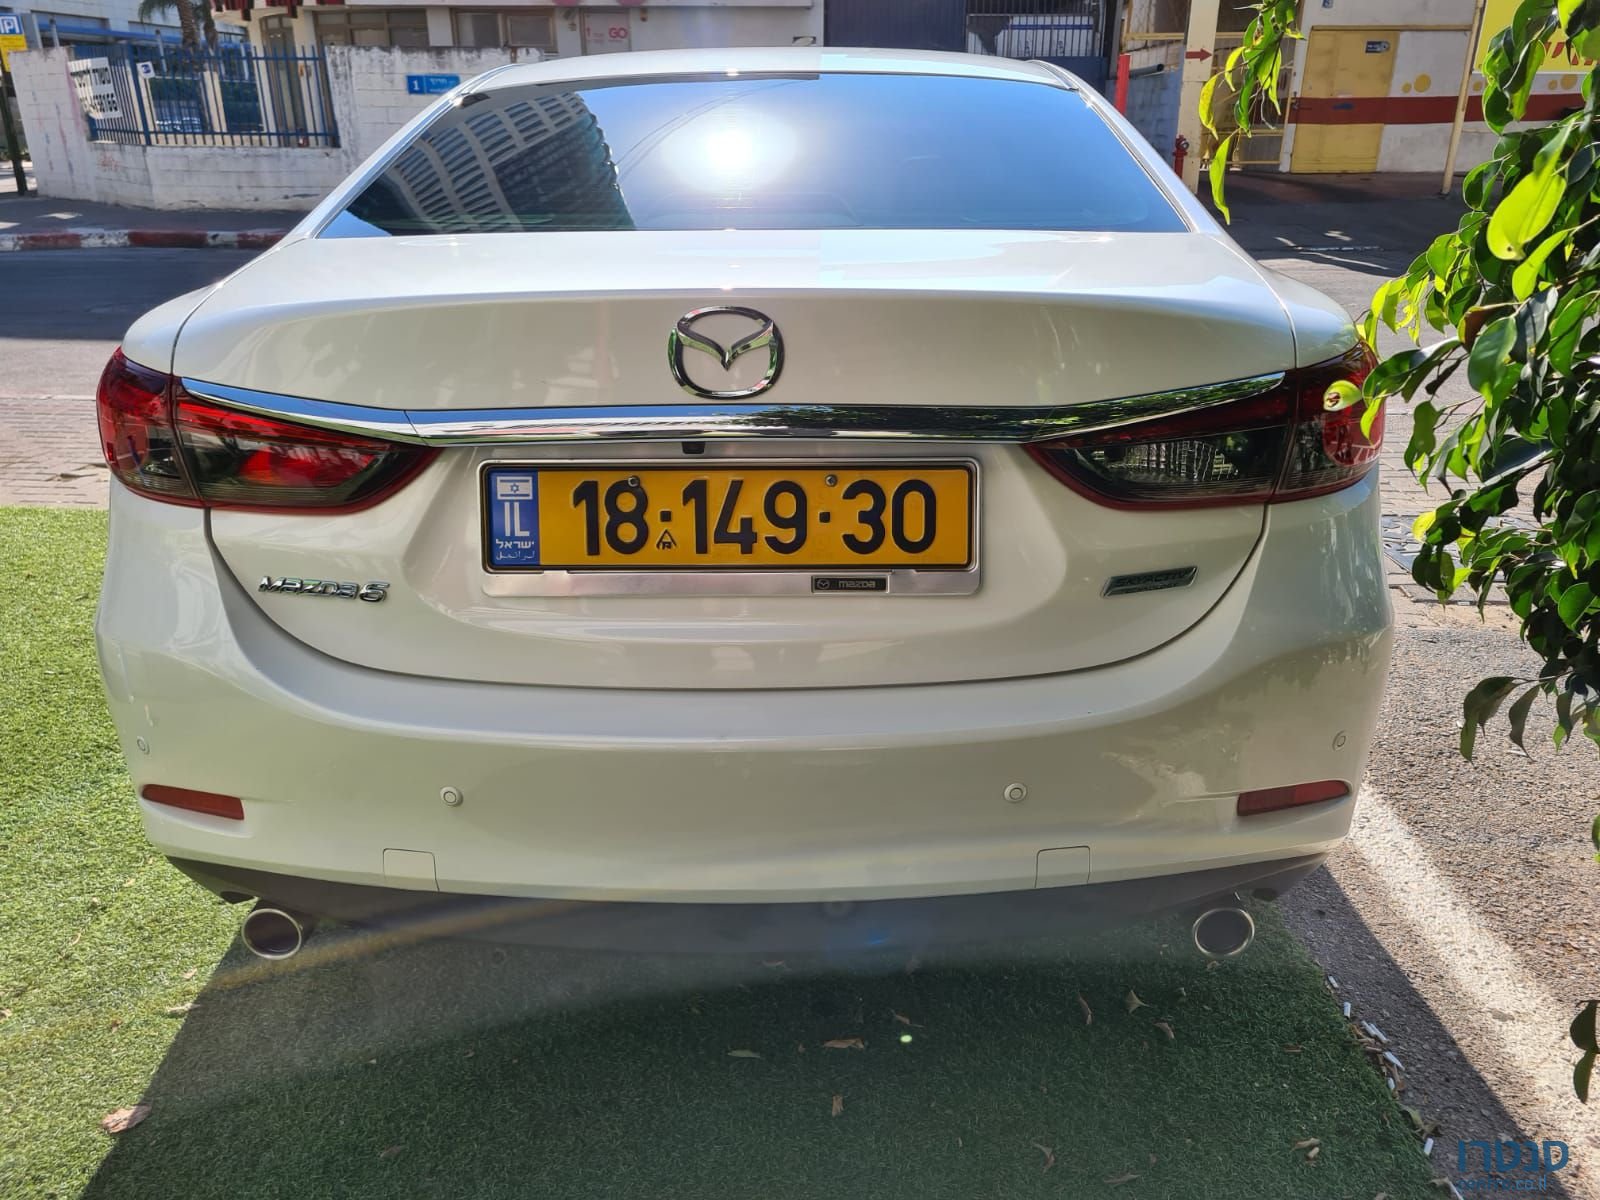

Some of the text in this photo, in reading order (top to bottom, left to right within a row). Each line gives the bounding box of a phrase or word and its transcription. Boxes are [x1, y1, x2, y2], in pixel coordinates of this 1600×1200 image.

[608, 27, 628, 39] GO
[412, 79, 420, 91] 1
[504, 501, 530, 537] IL
[495, 538, 535, 549] ישראל
